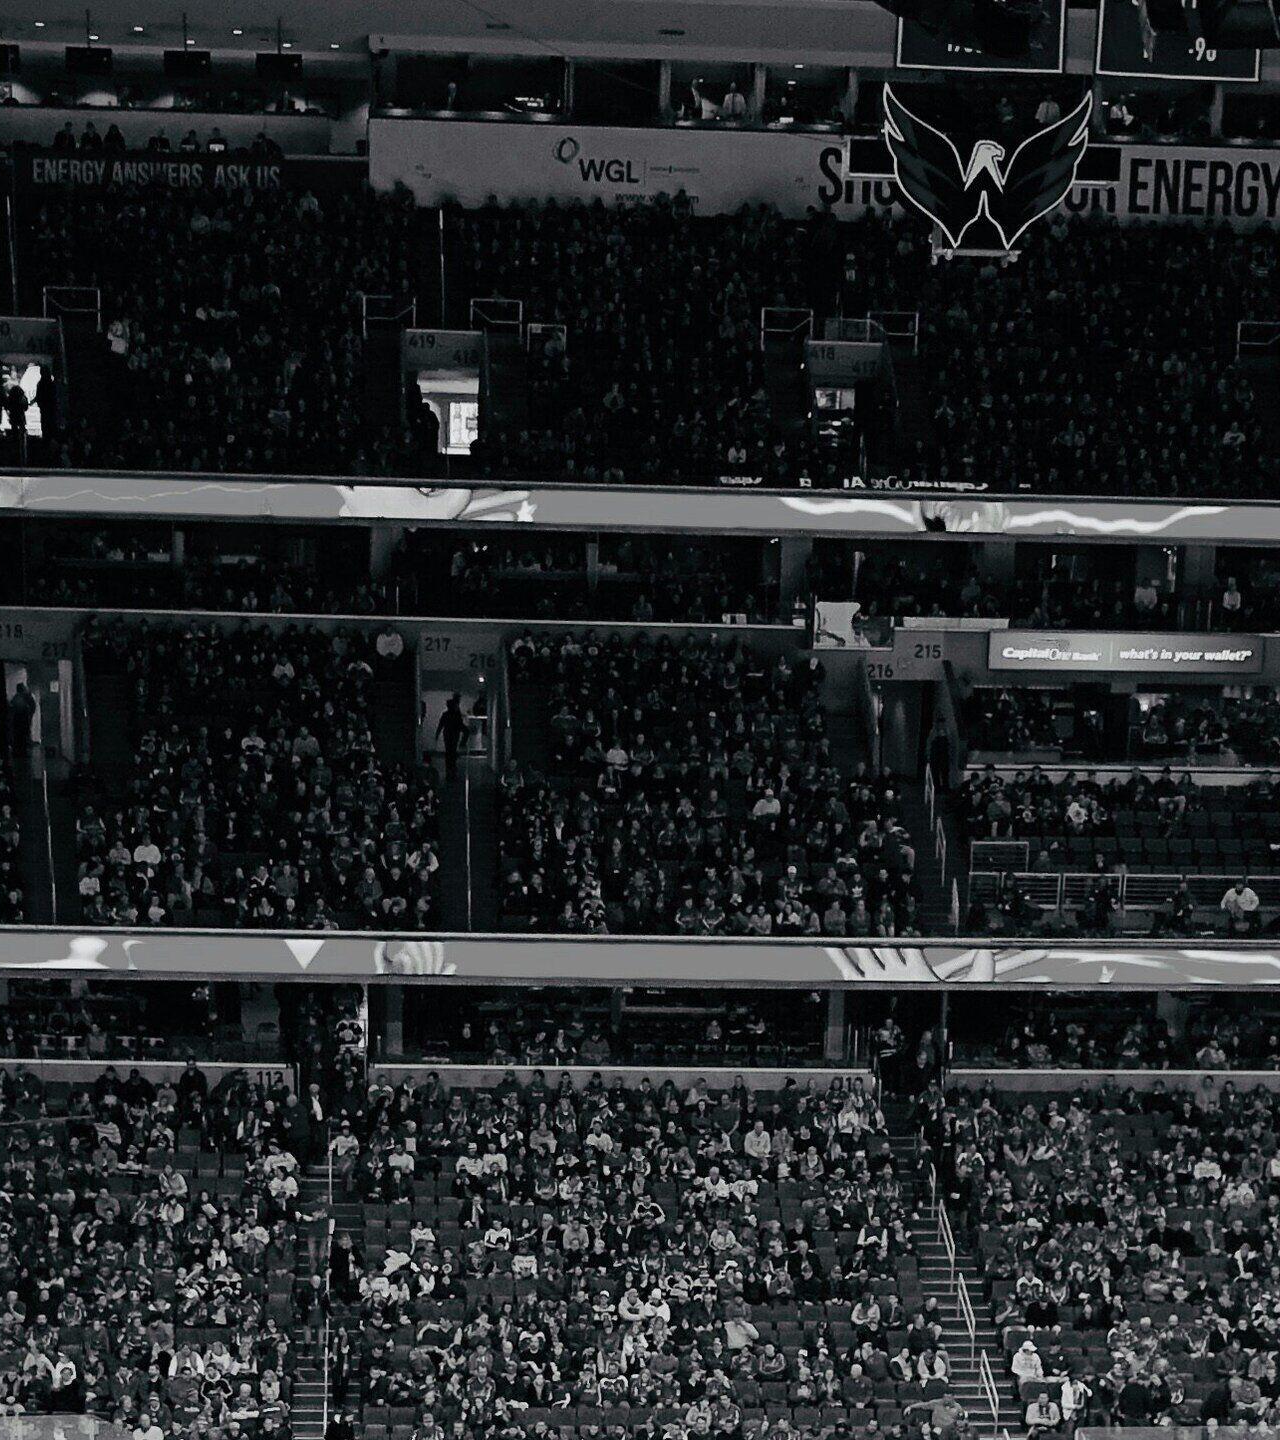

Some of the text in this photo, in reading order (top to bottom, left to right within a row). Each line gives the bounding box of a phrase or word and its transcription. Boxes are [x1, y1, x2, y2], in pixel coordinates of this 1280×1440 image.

[32, 157, 281, 190] ENERGY ANSWERS ASK US
[578, 159, 639, 184] WGL
[425, 636, 451, 652] 217
[913, 643, 942, 659] 215
[469, 652, 497, 668] 216
[1118, 646, 1159, 660] what's
[1161, 647, 1173, 660] in
[1174, 649, 1202, 664] your
[867, 663, 894, 679] 216
